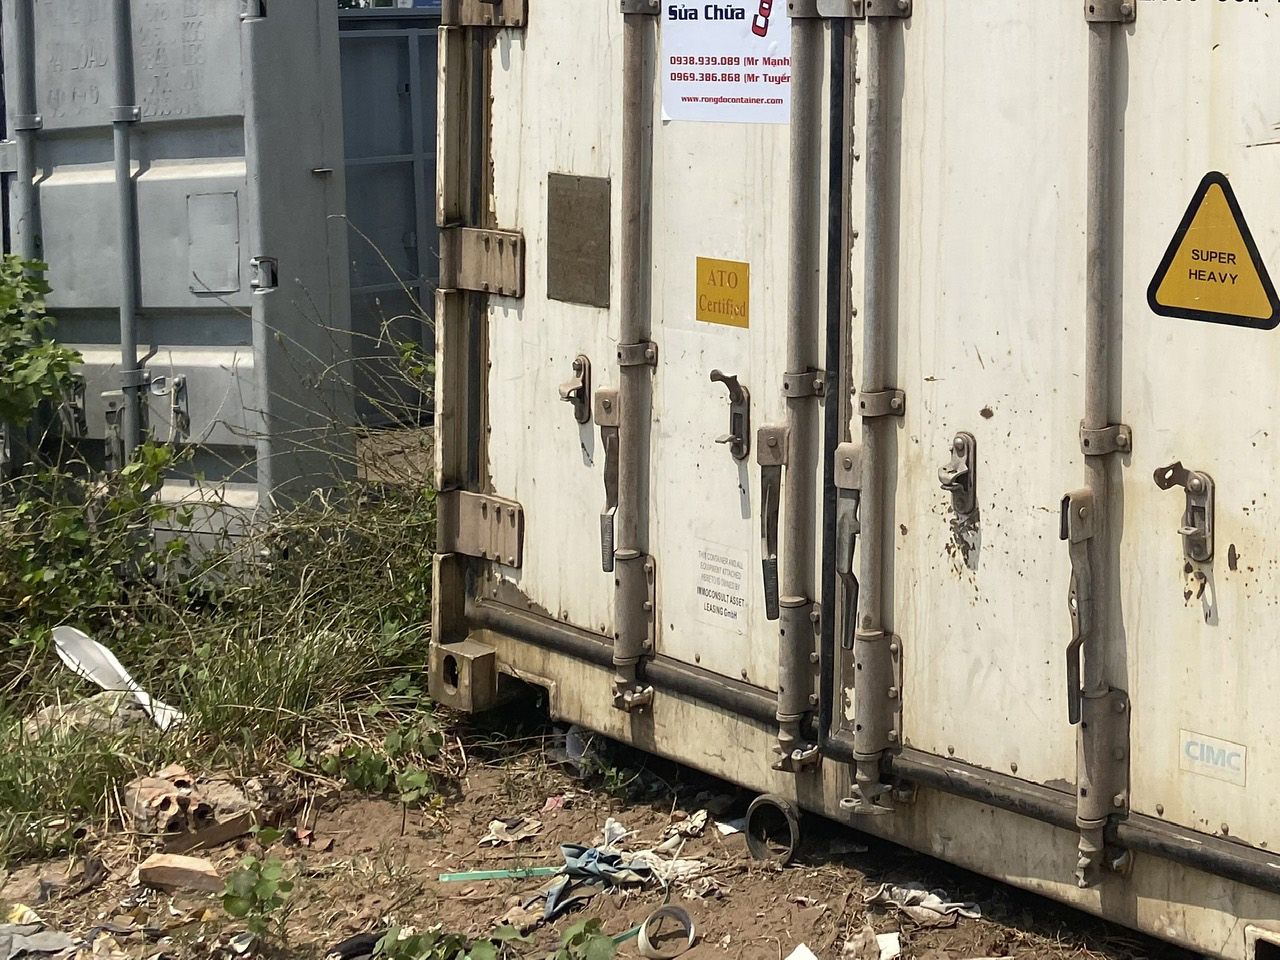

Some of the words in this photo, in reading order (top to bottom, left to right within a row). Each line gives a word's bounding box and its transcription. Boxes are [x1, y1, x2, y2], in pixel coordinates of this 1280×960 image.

[668, 3, 699, 21] Sửa
[704, 4, 746, 21] Chữa
[669, 56, 740, 66] 0938.939.089
[670, 72, 741, 82] 0969.386.868
[680, 95, 784, 105] www.rongdocontainer.com
[1191, 249, 1237, 266] SUPER
[707, 269, 738, 289] ATO
[1188, 269, 1239, 285] HEAVY
[698, 294, 746, 317] Certified
[1185, 740, 1241, 771] CIMC
